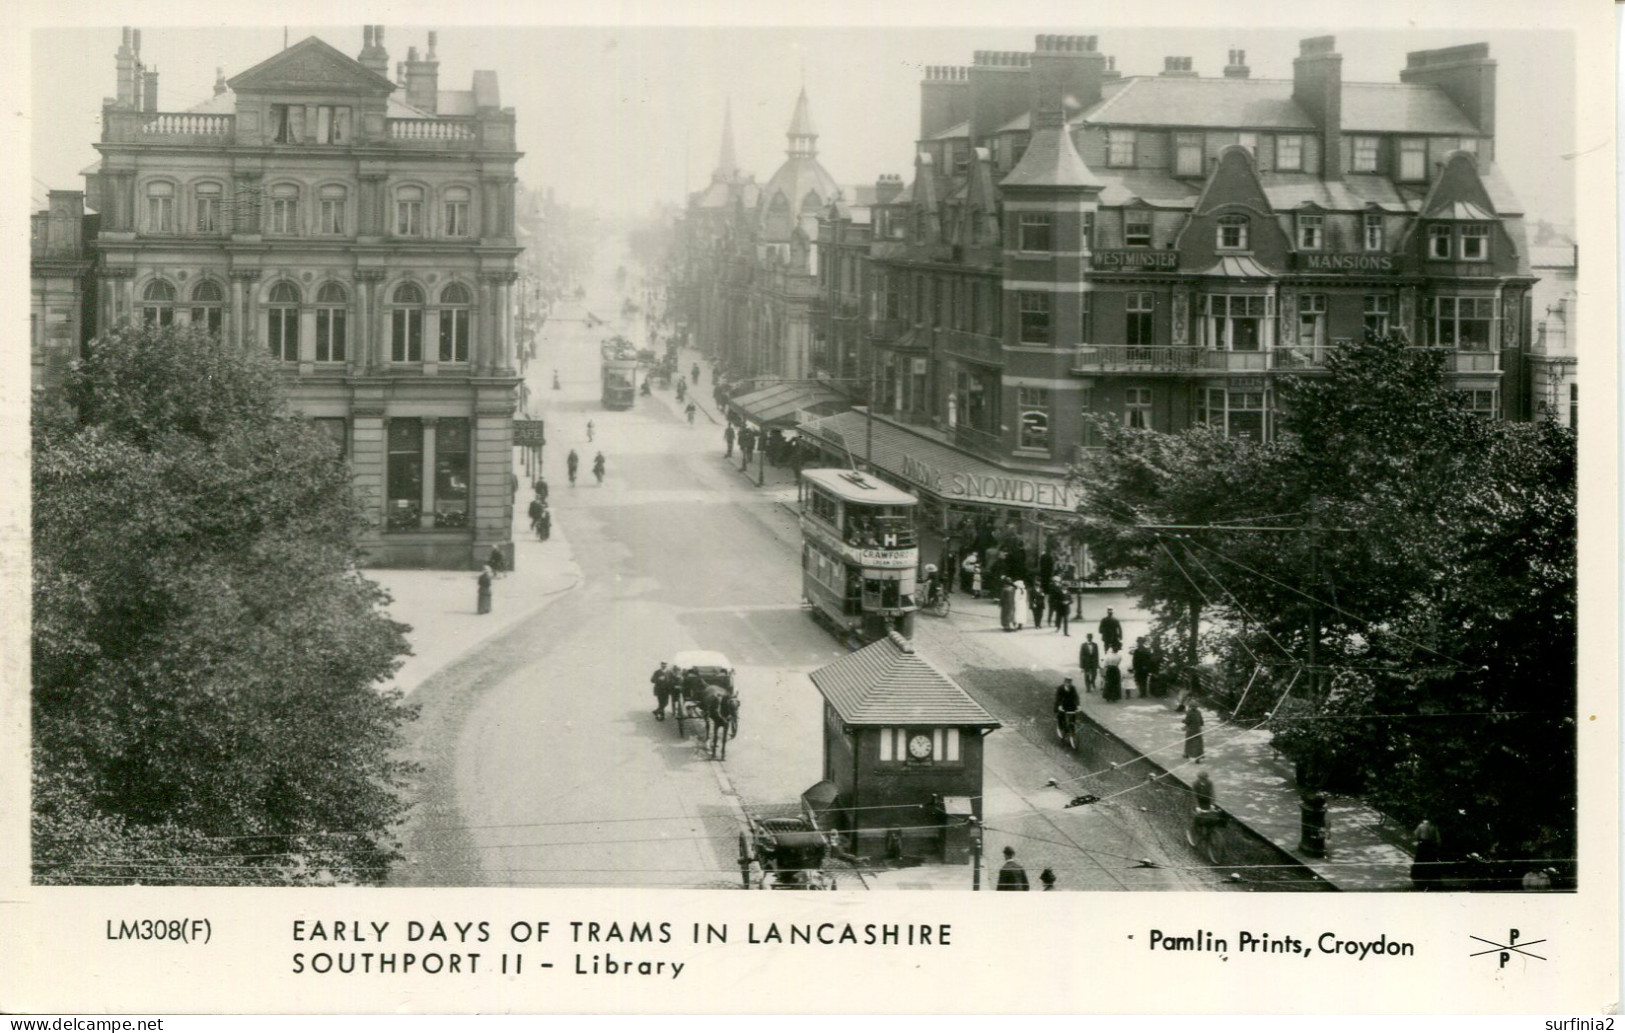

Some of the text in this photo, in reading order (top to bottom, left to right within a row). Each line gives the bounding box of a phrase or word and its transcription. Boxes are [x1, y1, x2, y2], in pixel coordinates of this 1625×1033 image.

[1094, 251, 1177, 266] WESTMINSTER
[1307, 254, 1392, 270] MANSIONS
[951, 472, 1068, 508] SNOWDEN
[884, 533, 897, 547] H
[108, 918, 212, 944] LM308(F)
[293, 920, 951, 946] EARLY DAYS OF TRAMS IN LANCASHIRE
[1150, 929, 1414, 961] Pamlin Prints, Croydon
[292, 952, 481, 974] SOUTHPORT
[575, 953, 685, 979] Library
